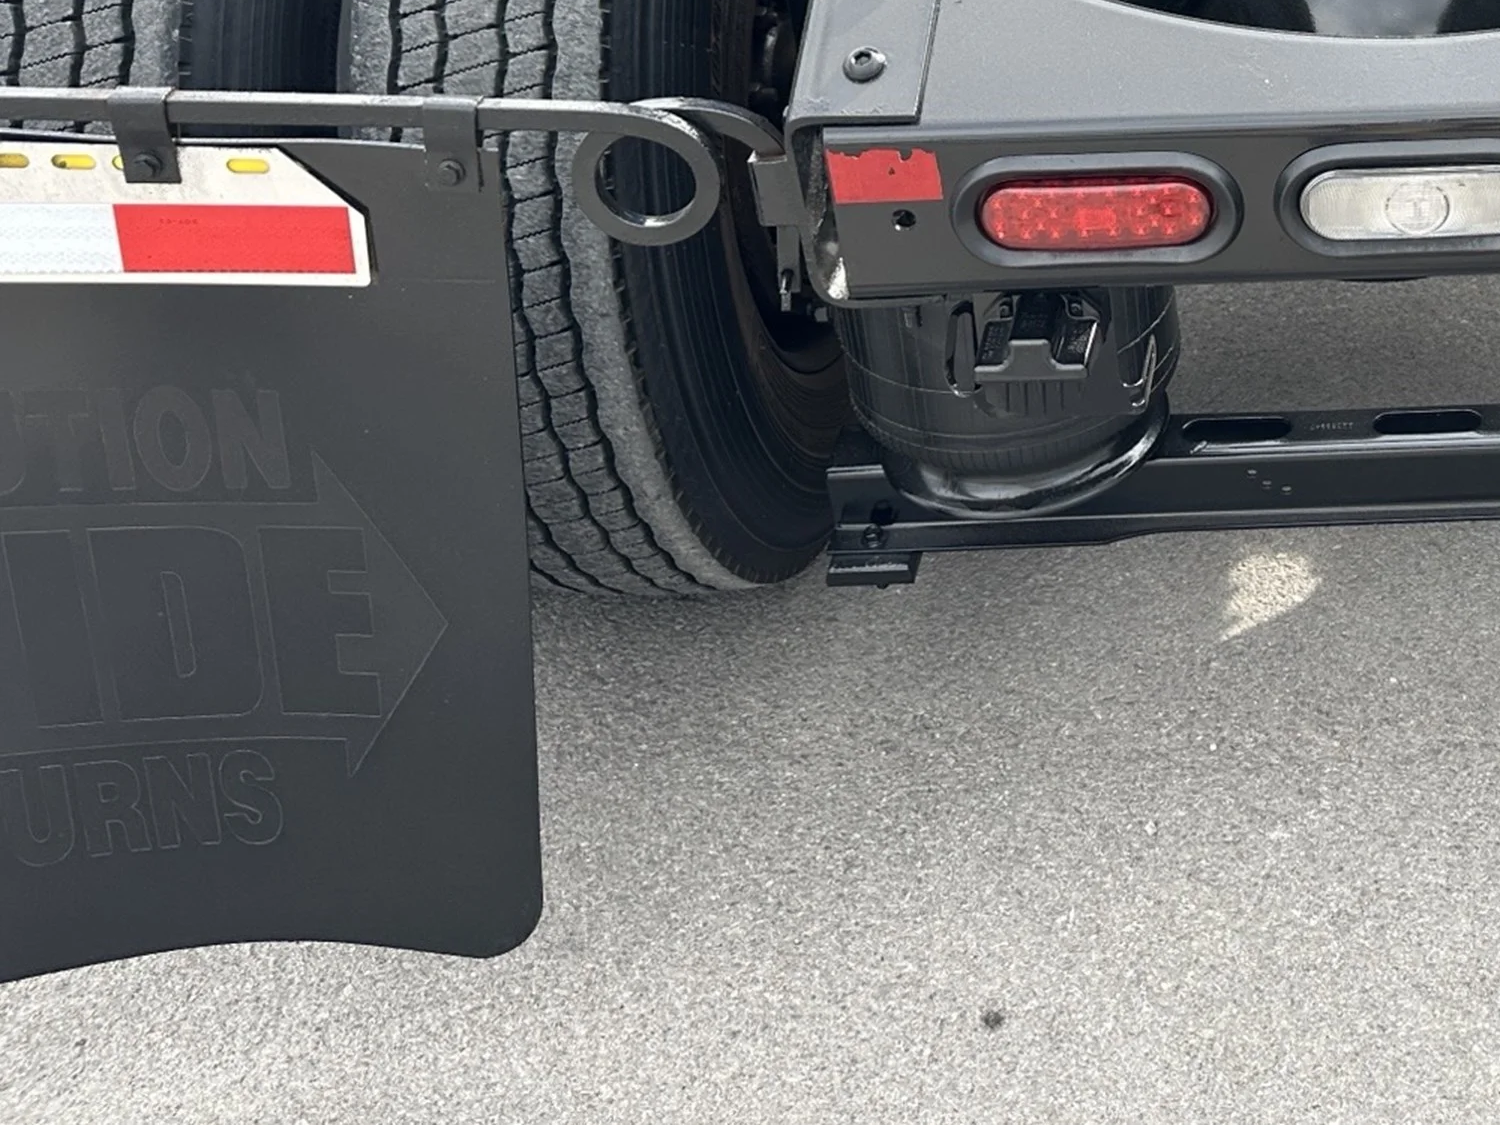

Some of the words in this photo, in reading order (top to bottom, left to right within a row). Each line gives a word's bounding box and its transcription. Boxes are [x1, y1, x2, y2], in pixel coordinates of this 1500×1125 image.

[0, 384, 292, 497] TION
[0, 524, 383, 730] IDE
[0, 748, 285, 867] URNS
